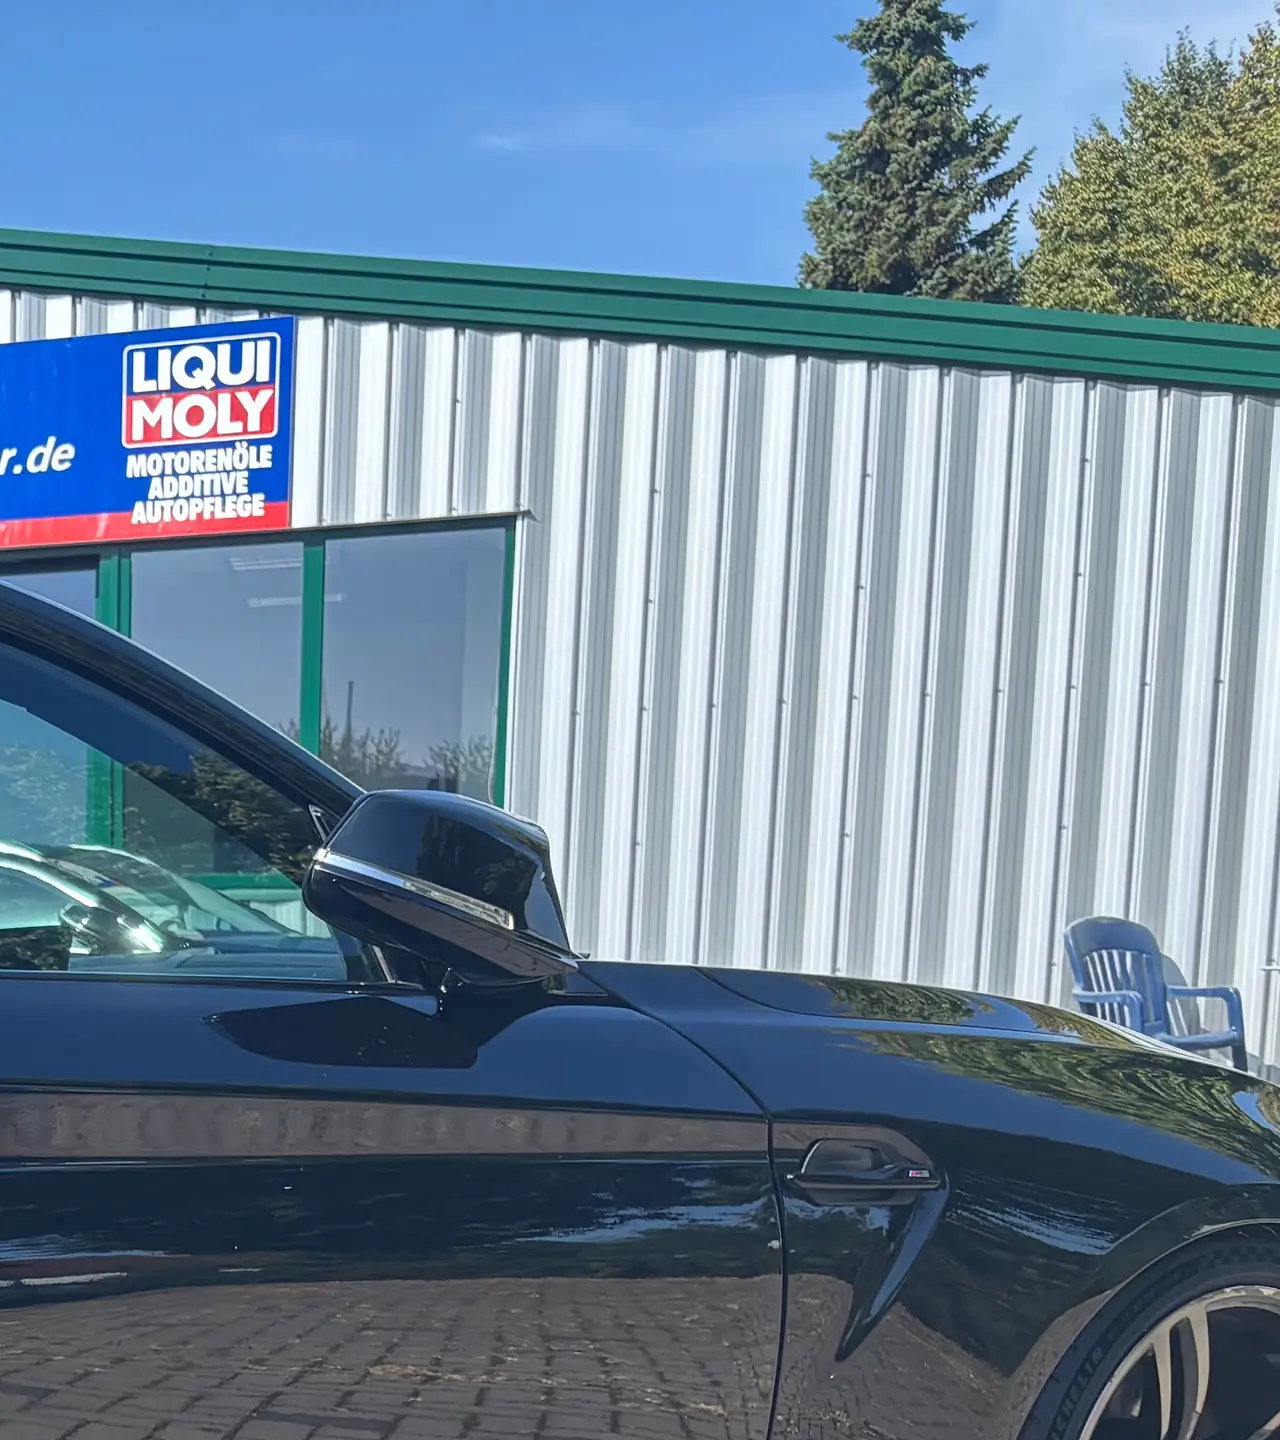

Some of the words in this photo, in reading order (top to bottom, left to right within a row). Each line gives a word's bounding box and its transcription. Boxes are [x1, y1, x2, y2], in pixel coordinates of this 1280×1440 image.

[132, 339, 271, 393] LIQUI
[131, 389, 274, 441] MOLY
[126, 441, 273, 478] MOTORENÖLE
[148, 471, 249, 499] ADDITIVE
[131, 493, 265, 524] AUTOPFLEGE
